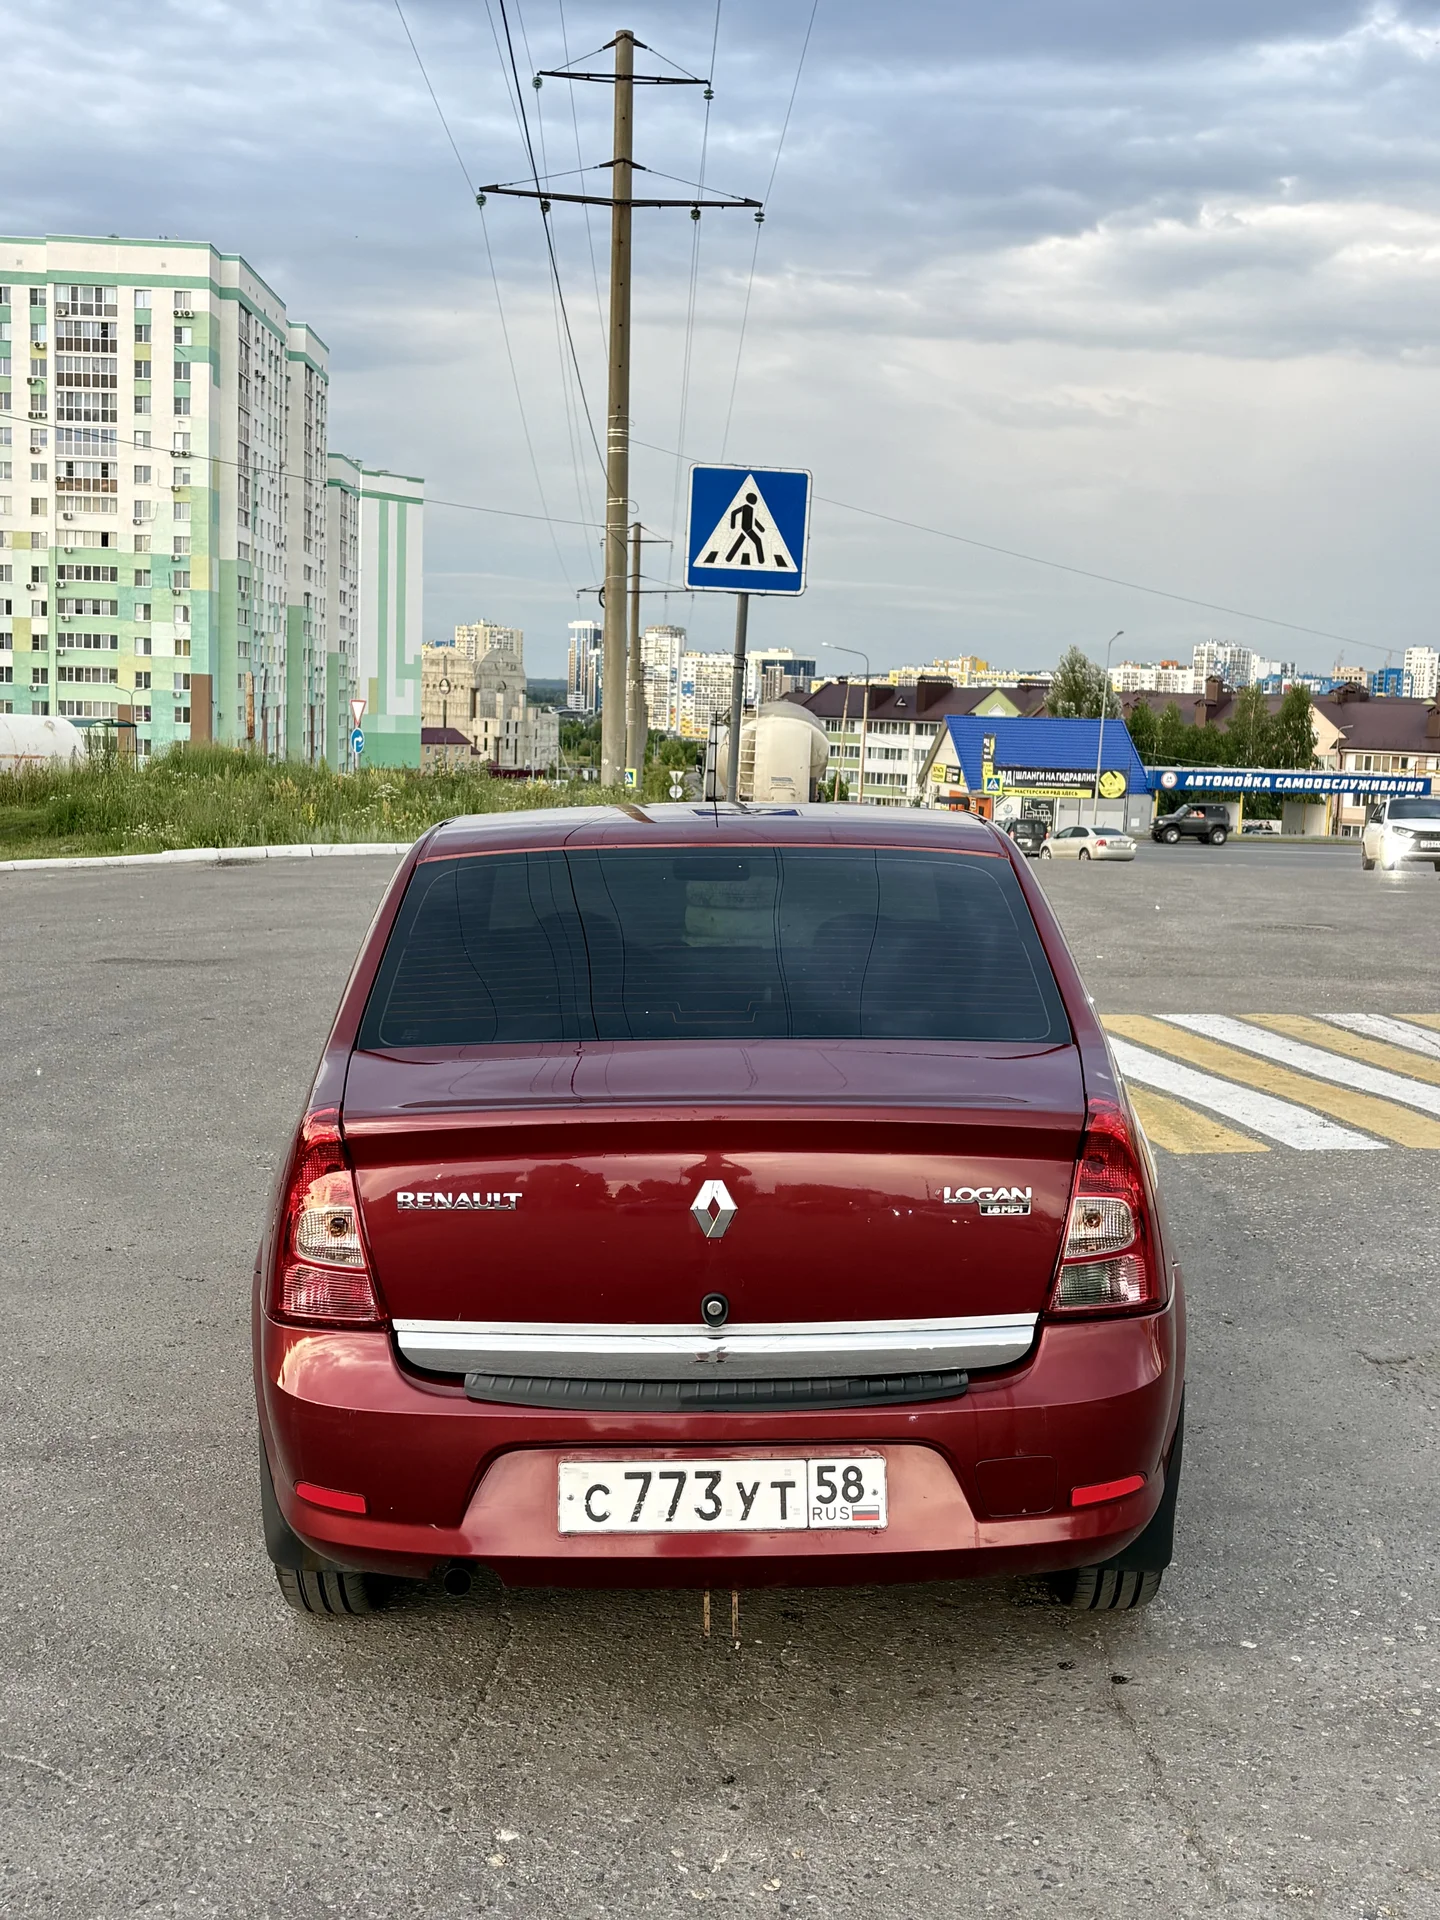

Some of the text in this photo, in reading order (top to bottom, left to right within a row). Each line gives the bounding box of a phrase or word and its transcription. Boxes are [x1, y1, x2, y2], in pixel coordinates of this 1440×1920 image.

[1015, 770, 1045, 781] ШЛАНГИ
[1046, 772, 1055, 781] НА
[1056, 772, 1097, 782] ГИДРАВЛИК
[1185, 774, 1424, 792] АВТОМОЙКА САМООБСЛУЖИВАНИЯ
[397, 1192, 523, 1210] RENAULT
[943, 1187, 1032, 1203] LOGAN
[815, 1466, 865, 1504] 58
[812, 1507, 850, 1520] RUS
